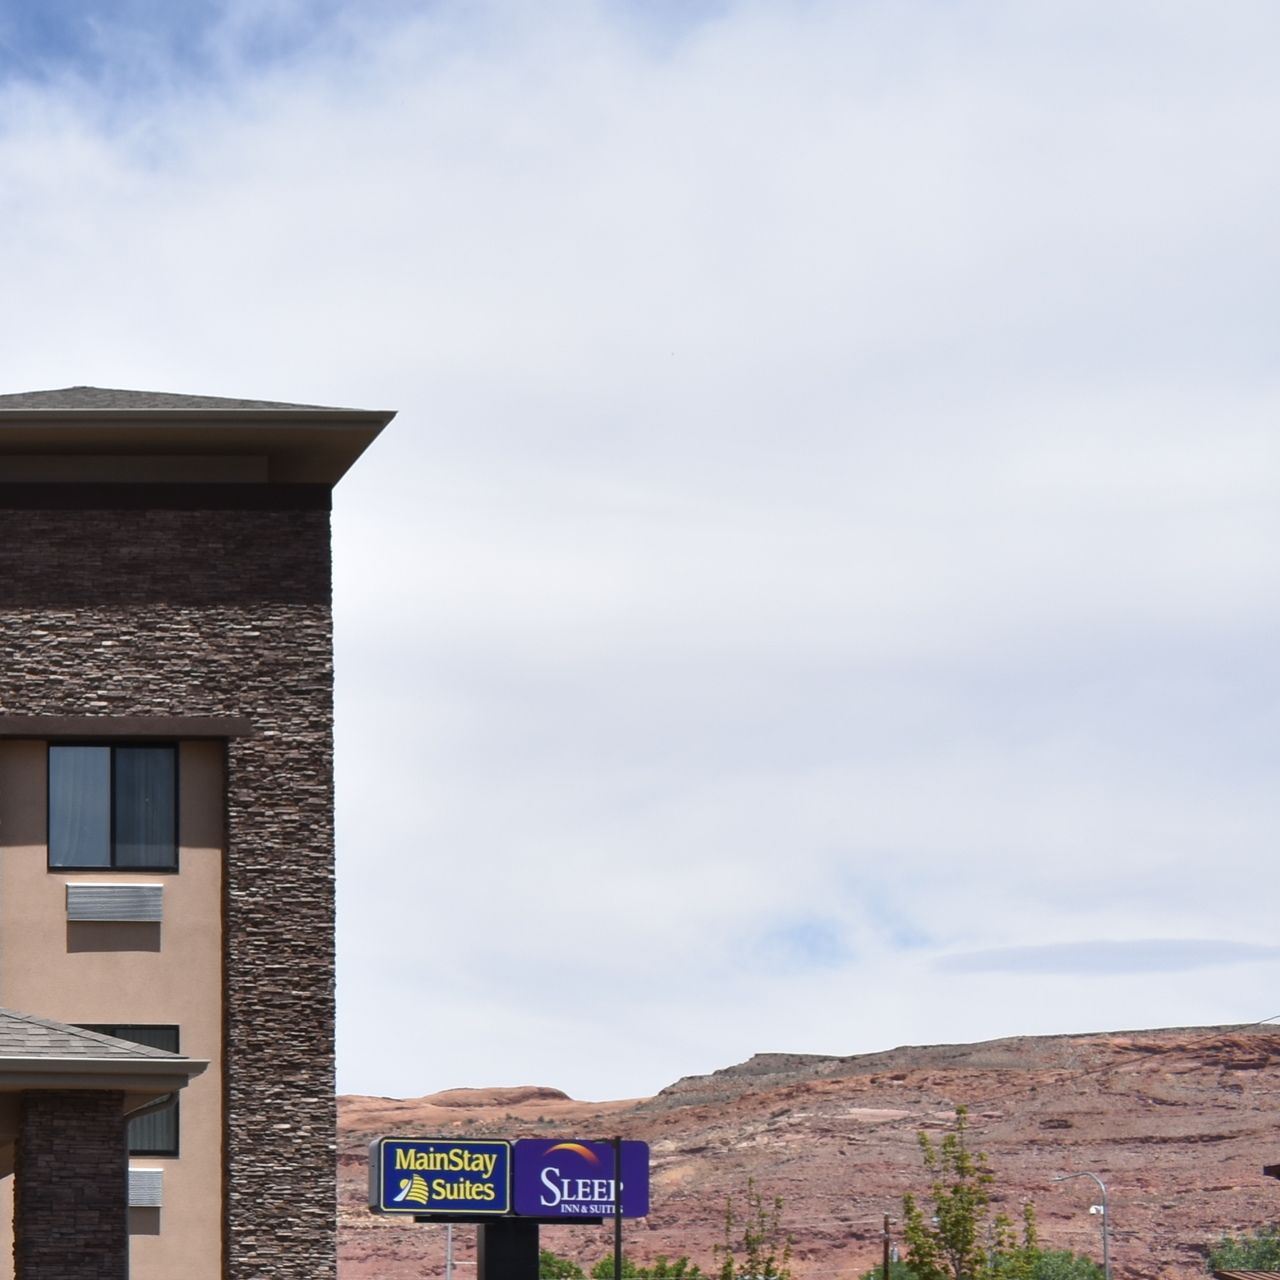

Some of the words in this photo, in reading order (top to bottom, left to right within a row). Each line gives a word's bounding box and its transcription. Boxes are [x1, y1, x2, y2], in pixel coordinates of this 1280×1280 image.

[395, 1147, 497, 1179] MainStay
[432, 1177, 495, 1200] Suites
[561, 1204, 579, 1213] INN
[581, 1205, 588, 1213] &
